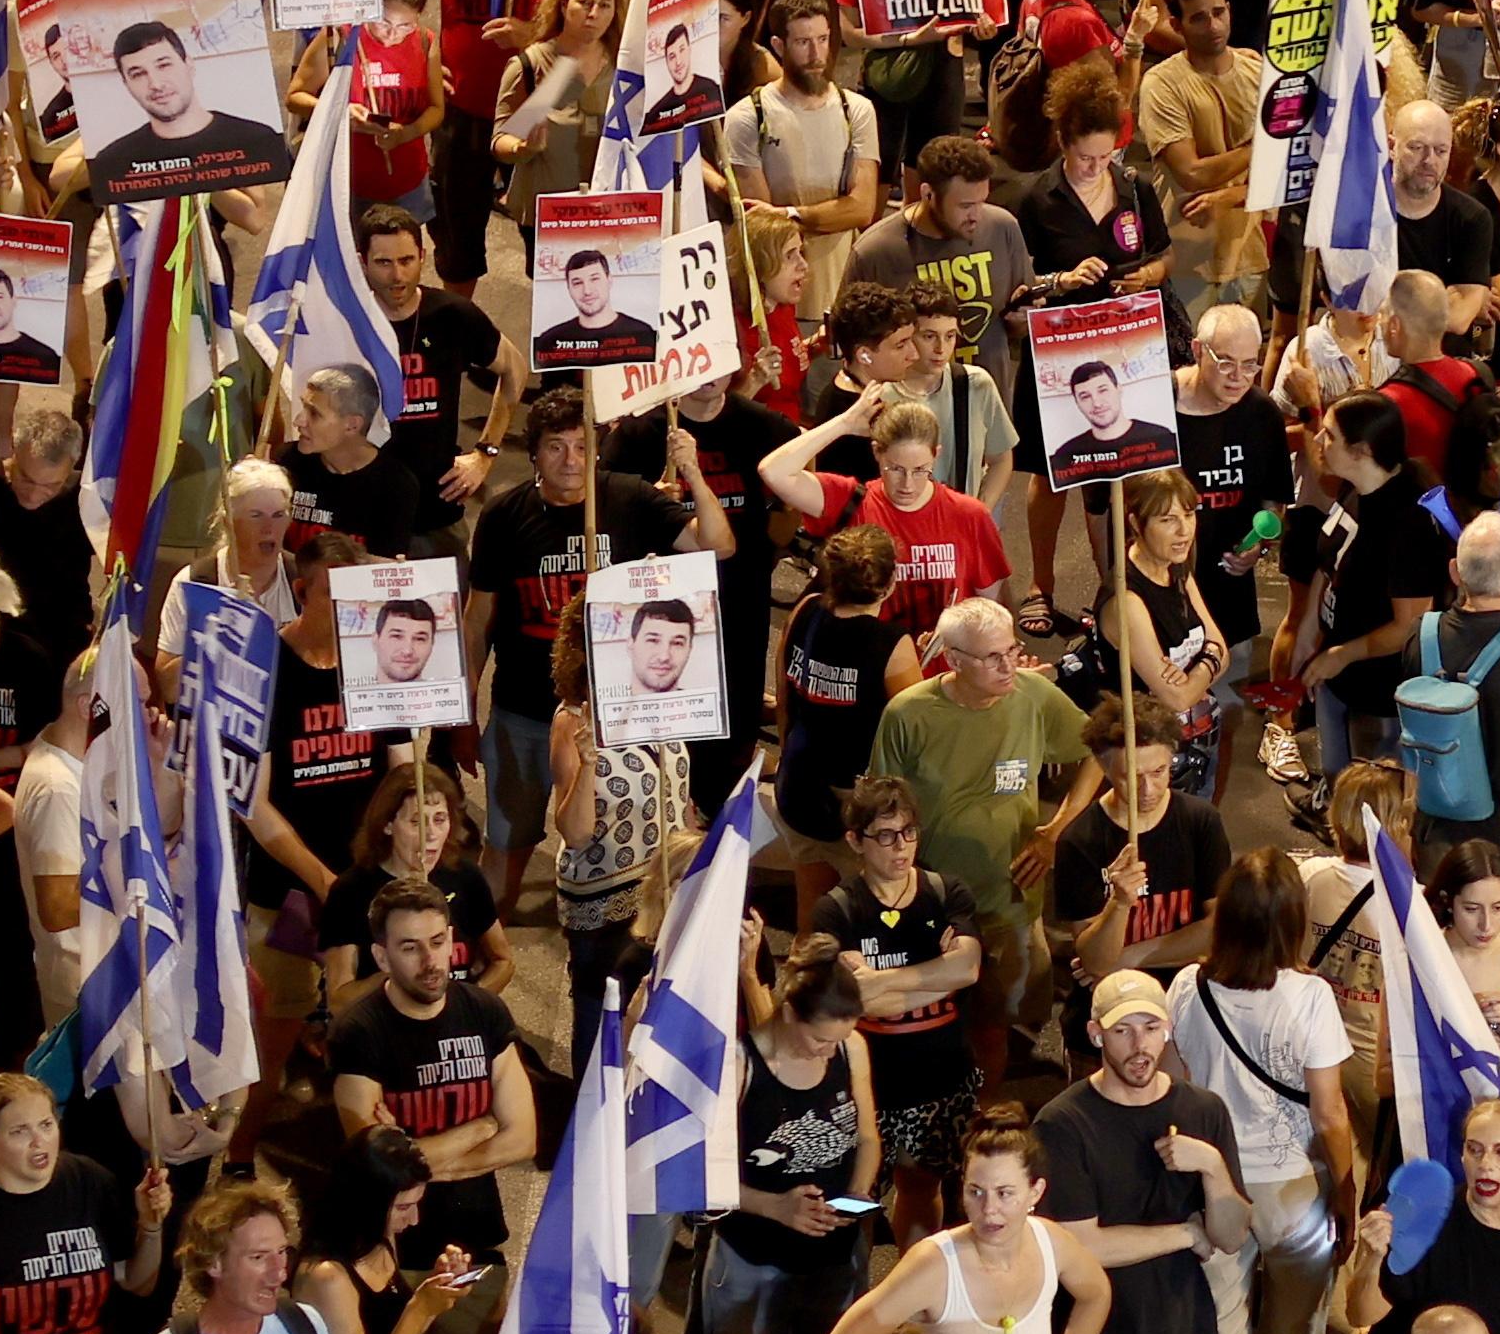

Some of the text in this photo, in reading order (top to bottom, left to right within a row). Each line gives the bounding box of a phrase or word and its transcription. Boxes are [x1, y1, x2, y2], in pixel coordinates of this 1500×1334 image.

[1223, 445, 1245, 465] בן
[1198, 467, 1244, 486] גביר
[45, 1226, 99, 1254] מחזירים
[21, 1248, 106, 1282] אותם הביתה
